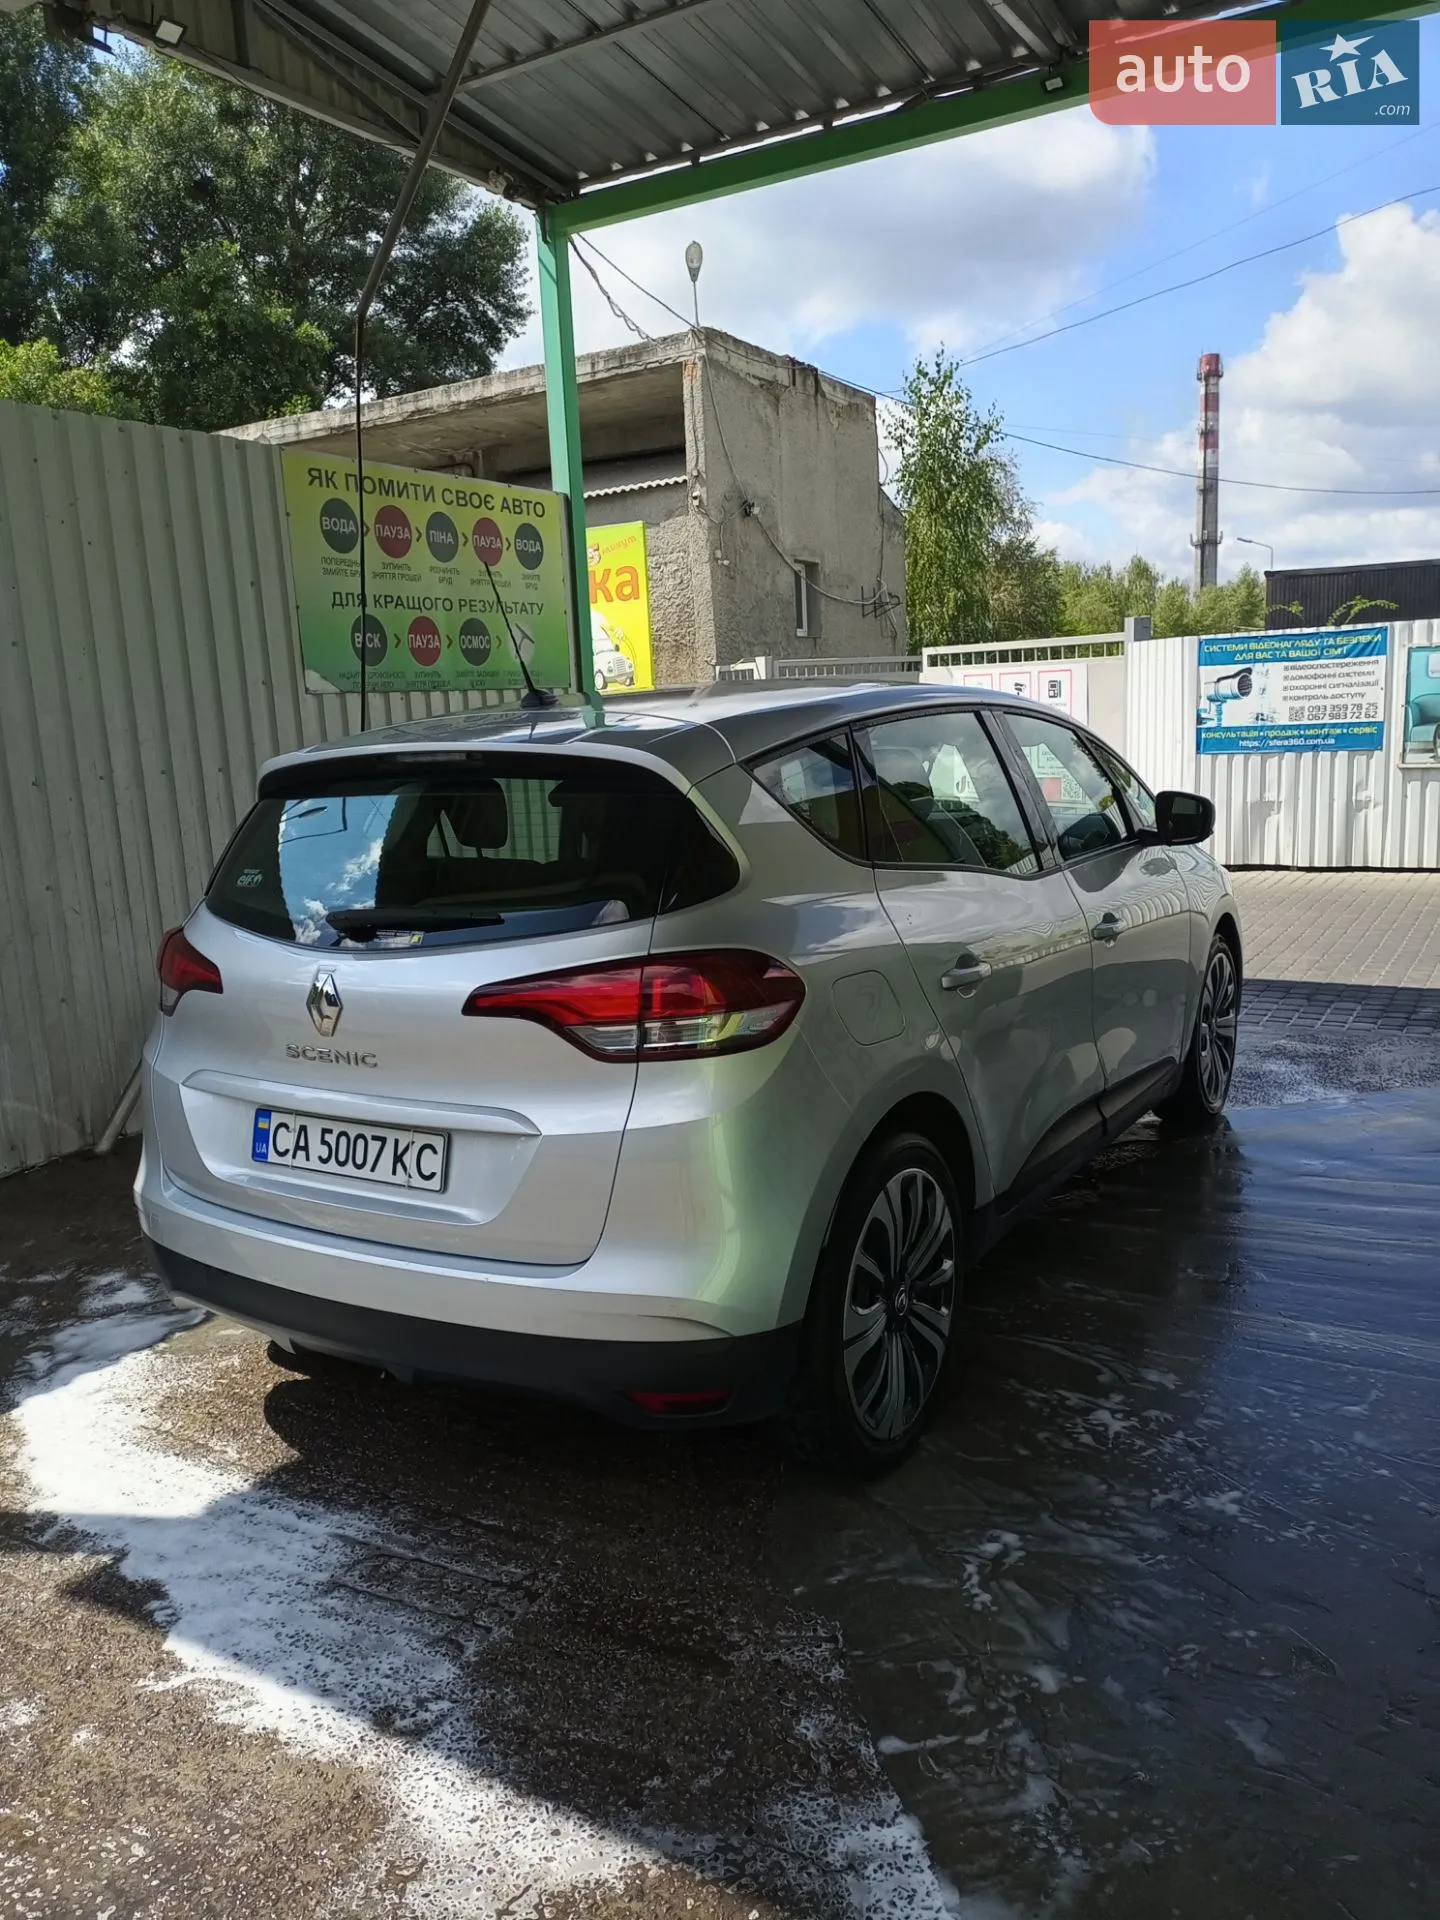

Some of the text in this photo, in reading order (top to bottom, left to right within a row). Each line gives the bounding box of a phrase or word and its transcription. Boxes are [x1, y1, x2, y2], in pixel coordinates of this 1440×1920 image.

[307, 467, 546, 518] ЯК ПОМИТИ СВОЄ АВТО
[321, 516, 542, 554] ВОДА ПАУЗА ПІНА ПАУЗА ВОДА
[320, 556, 361, 568] ПОПЕРЕДНЬ
[588, 565, 640, 605] ка
[331, 591, 544, 616] ДЛЯ КРАЩОГО РЕЗУЛЬТАТУ
[354, 632, 490, 649] ВСК ПАУЗА ОСМОС
[1204, 643, 1248, 652] СИСТЕМИ
[1249, 638, 1320, 650] ВІДЕОНАГЛЯДУ
[1323, 637, 1334, 645] ТА
[1234, 652, 1254, 661] ДЛЯ
[1255, 650, 1273, 660] ВАС
[1275, 649, 1287, 658] ТА
[1290, 671, 1337, 681] домофонні
[1289, 682, 1327, 692] охоронні
[1289, 691, 1366, 702] контроль доступу
[1307, 702, 1378, 713] 093 359 78 25
[1307, 710, 1378, 721] 067 983 72 62
[1201, 729, 1259, 739] консультація
[1264, 728, 1300, 738] продаж
[1305, 727, 1342, 736] монтаж
[1239, 737, 1336, 748] https://sfera360.com.ua
[286, 1043, 378, 1068] SCENIC
[255, 1122, 439, 1182] UA CA 5007 KC
